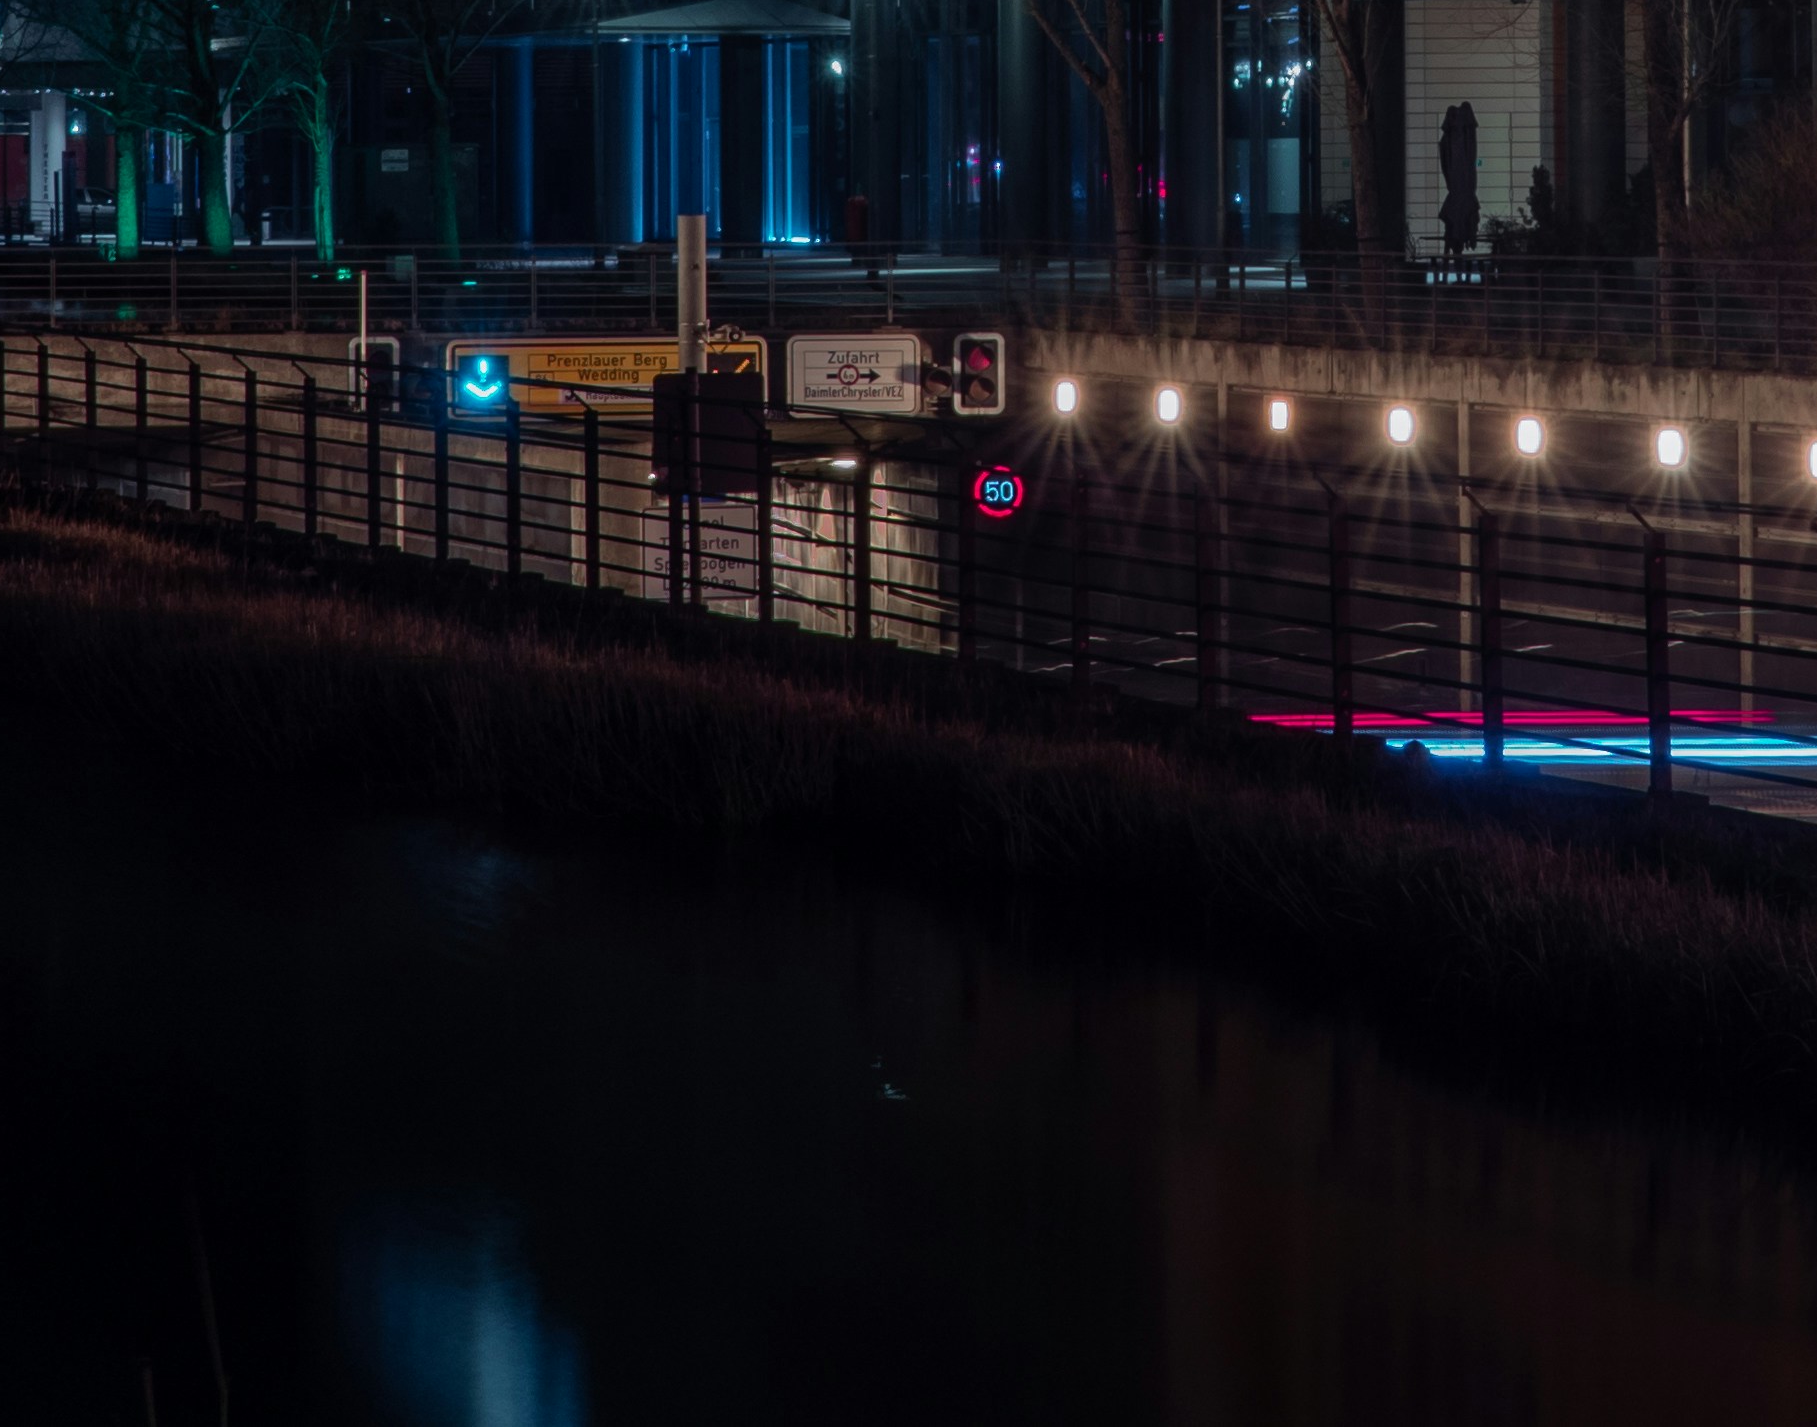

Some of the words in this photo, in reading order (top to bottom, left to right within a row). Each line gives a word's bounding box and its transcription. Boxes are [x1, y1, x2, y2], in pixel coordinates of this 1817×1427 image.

[547, 354, 626, 367] Prenzlauer
[633, 353, 667, 368] Berg
[828, 351, 880, 364] Zufahrt
[578, 369, 640, 383] Wedding
[805, 386, 903, 399] DaimlerChrysler/VEZ
[985, 481, 1014, 502] 50
[660, 536, 740, 551] Trarten
[654, 557, 746, 573] Speogen
